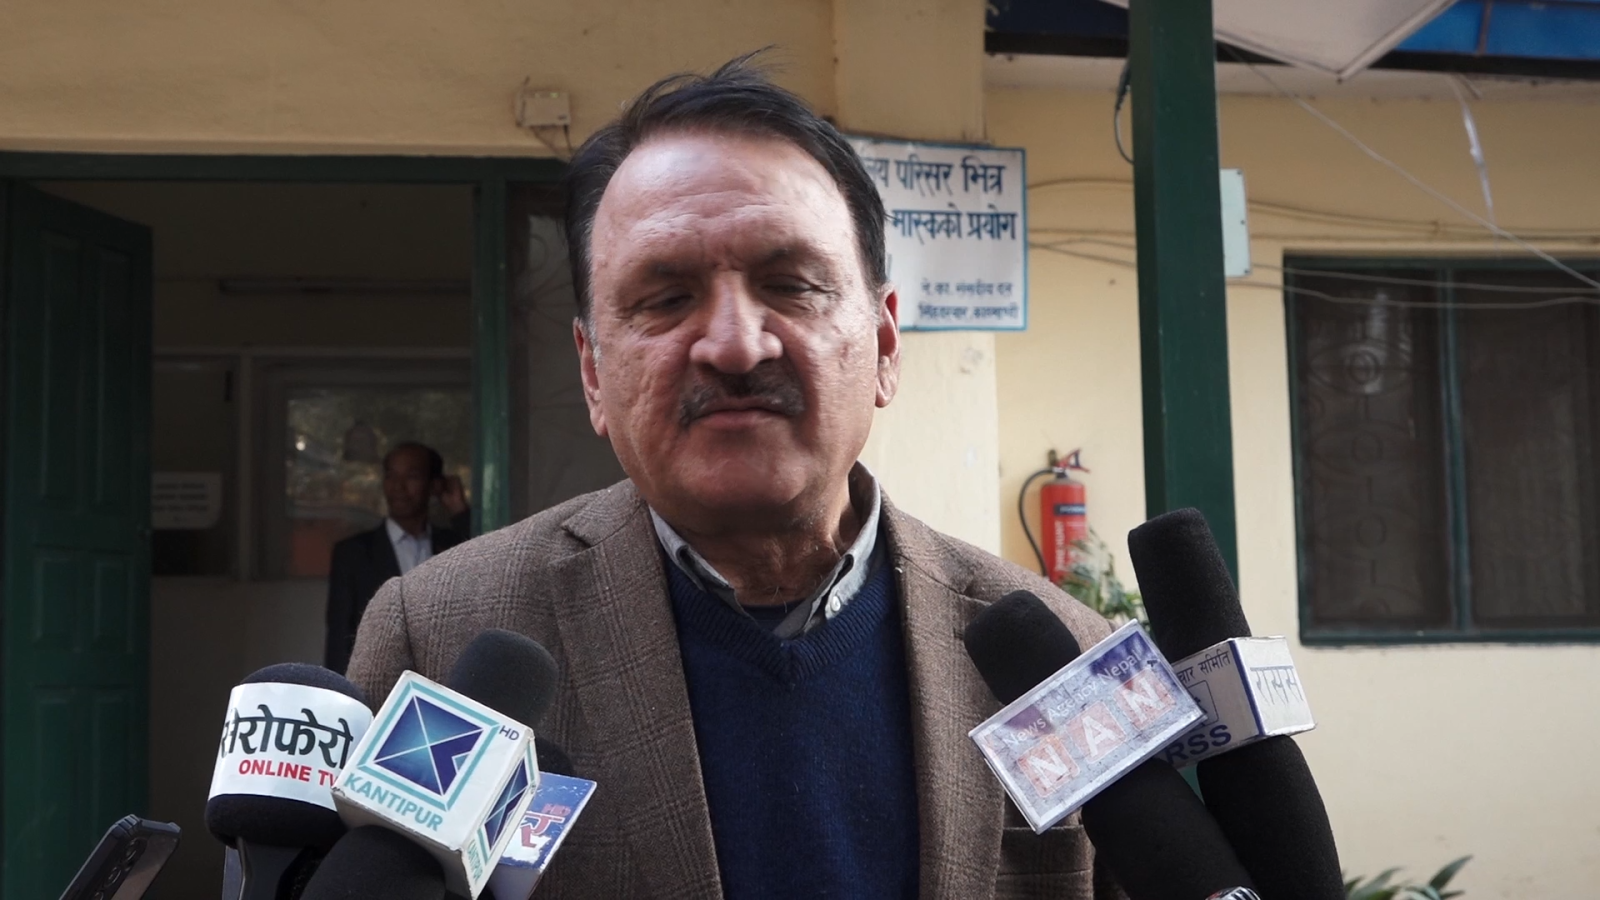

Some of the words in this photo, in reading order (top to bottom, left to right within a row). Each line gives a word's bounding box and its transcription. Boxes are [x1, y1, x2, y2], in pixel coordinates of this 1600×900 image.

[895, 154, 953, 197] परिसर
[961, 156, 1006, 194] भित्र
[892, 203, 963, 245] मास्कको
[968, 204, 1018, 241] प्रयोग
[1198, 648, 1232, 675] समिति
[1002, 717, 1048, 747] News
[1047, 680, 1100, 719] Agency
[1097, 648, 1142, 687] Nepal
[1250, 665, 1305, 706] रासस
[499, 725, 520, 741] HD
[1165, 724, 1232, 764] RSS
[239, 760, 312, 782] ONLINE
[344, 773, 443, 832] KANTIPUR
[542, 803, 571, 817] HD
